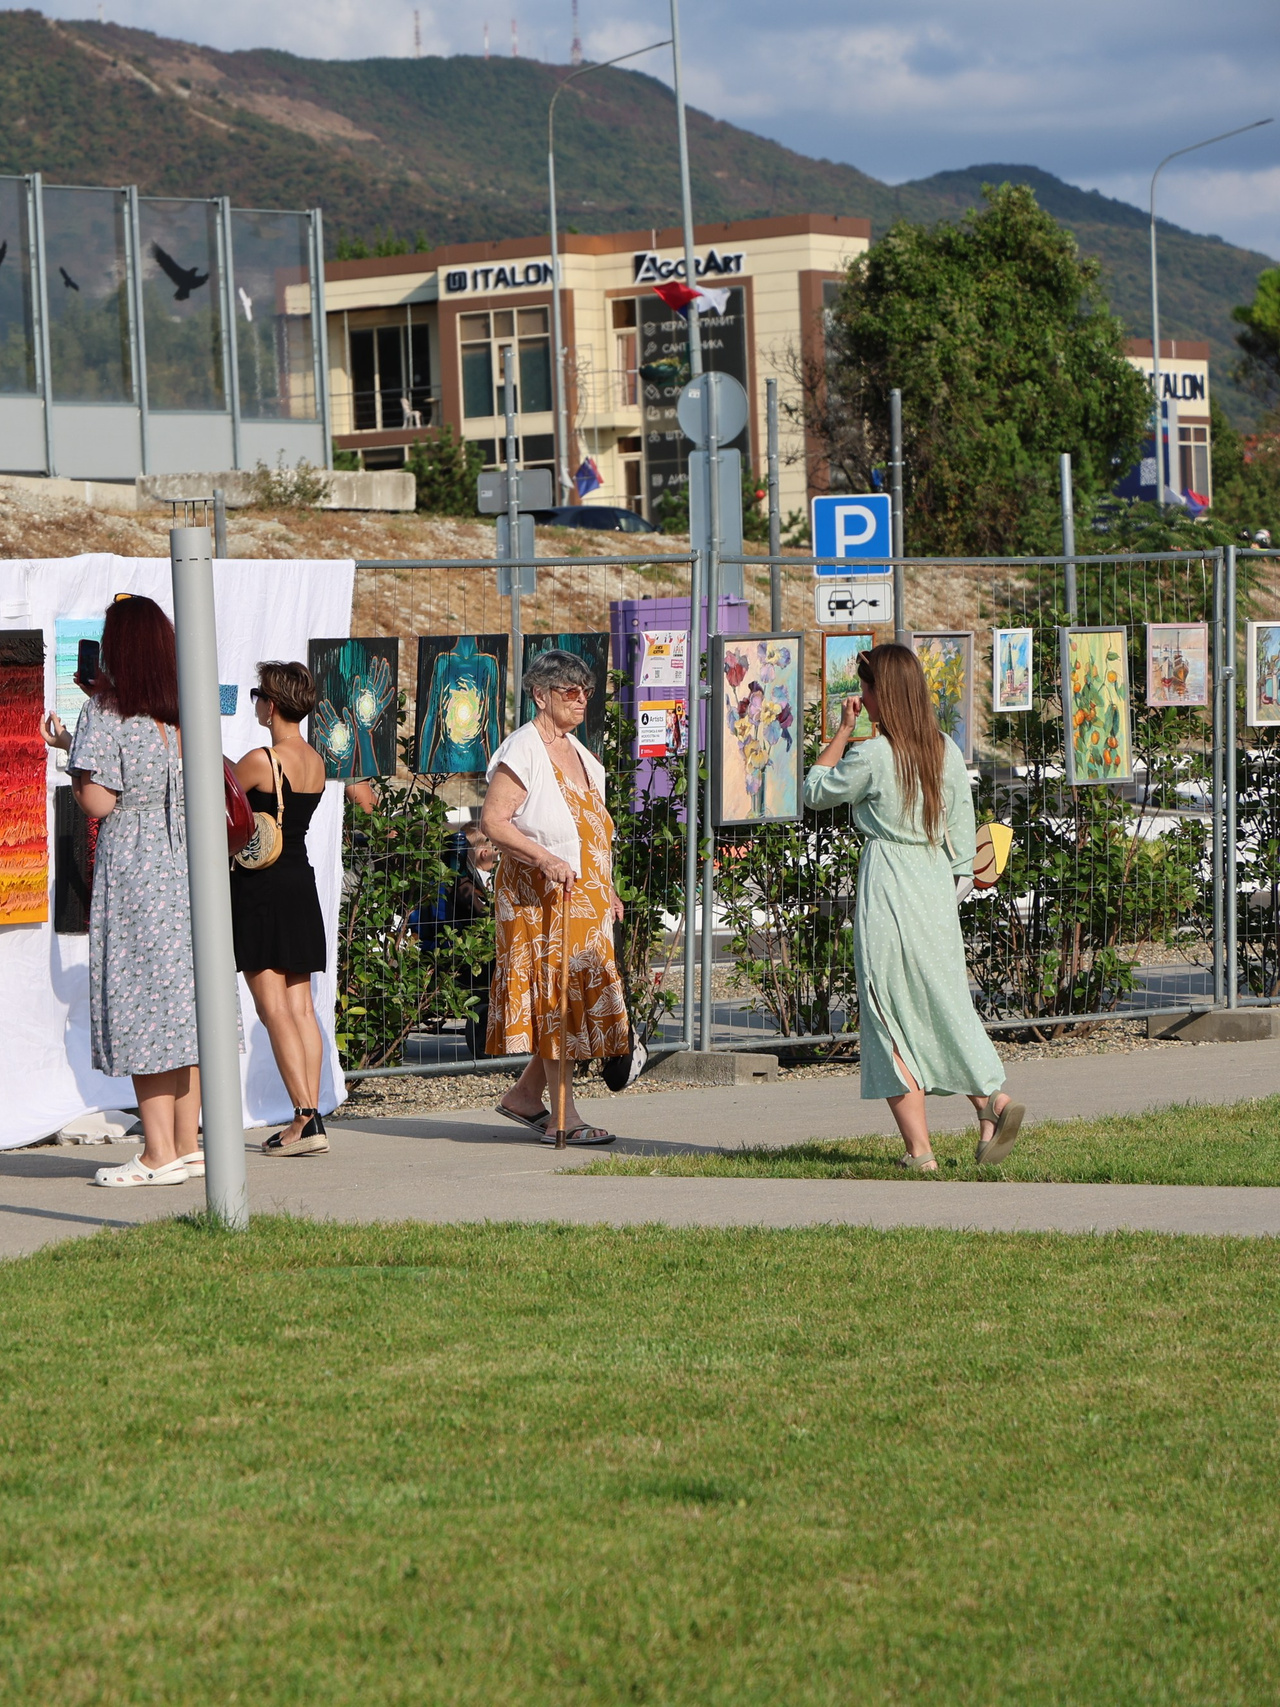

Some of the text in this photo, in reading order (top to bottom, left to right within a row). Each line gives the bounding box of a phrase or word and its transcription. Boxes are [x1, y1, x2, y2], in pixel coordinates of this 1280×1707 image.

[473, 261, 559, 291] ITALON
[660, 315, 734, 331] КЕРАГРАНИТ
[661, 339, 724, 354] САНТНИКА
[835, 505, 877, 567] P
